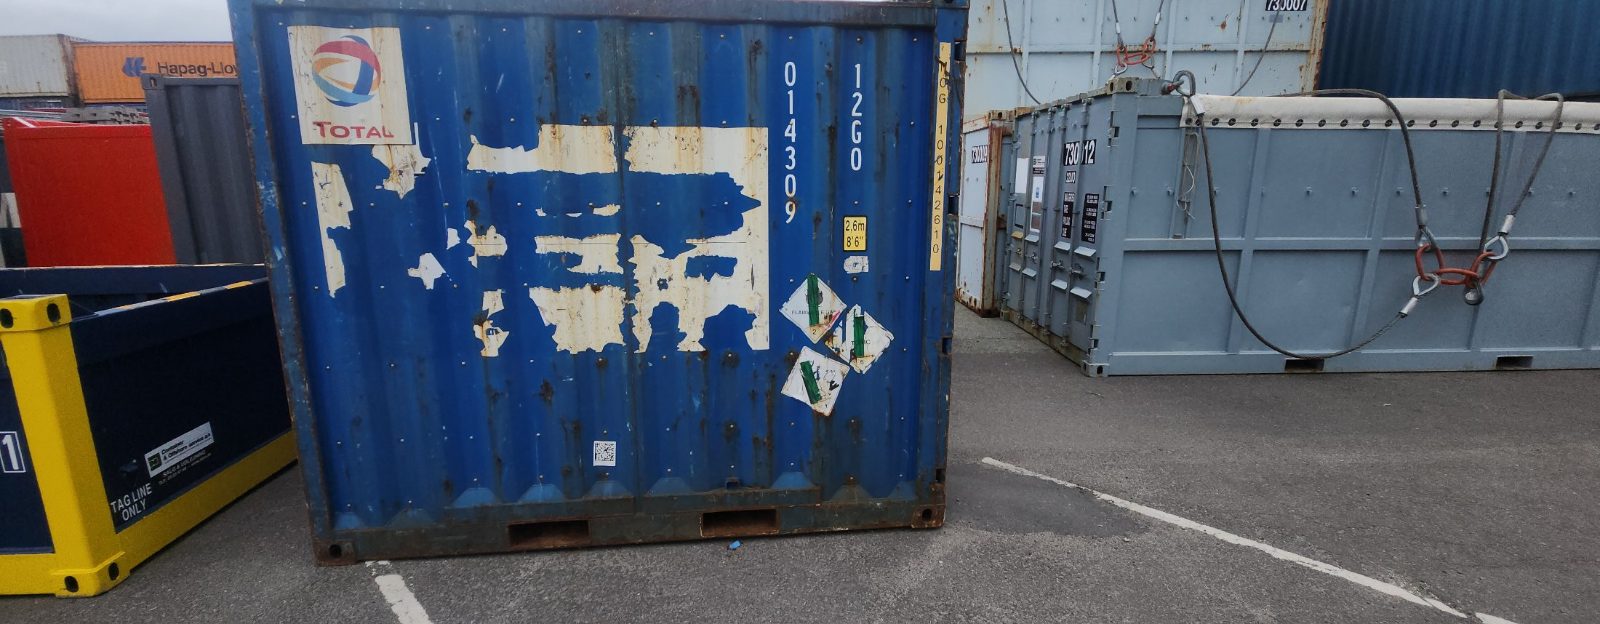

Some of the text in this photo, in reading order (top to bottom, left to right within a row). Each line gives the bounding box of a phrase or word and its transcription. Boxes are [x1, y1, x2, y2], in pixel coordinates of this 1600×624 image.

[784, 61, 796, 224] 014309
[110, 482, 152, 513] TAG LINE
[122, 498, 146, 521] ONLY
